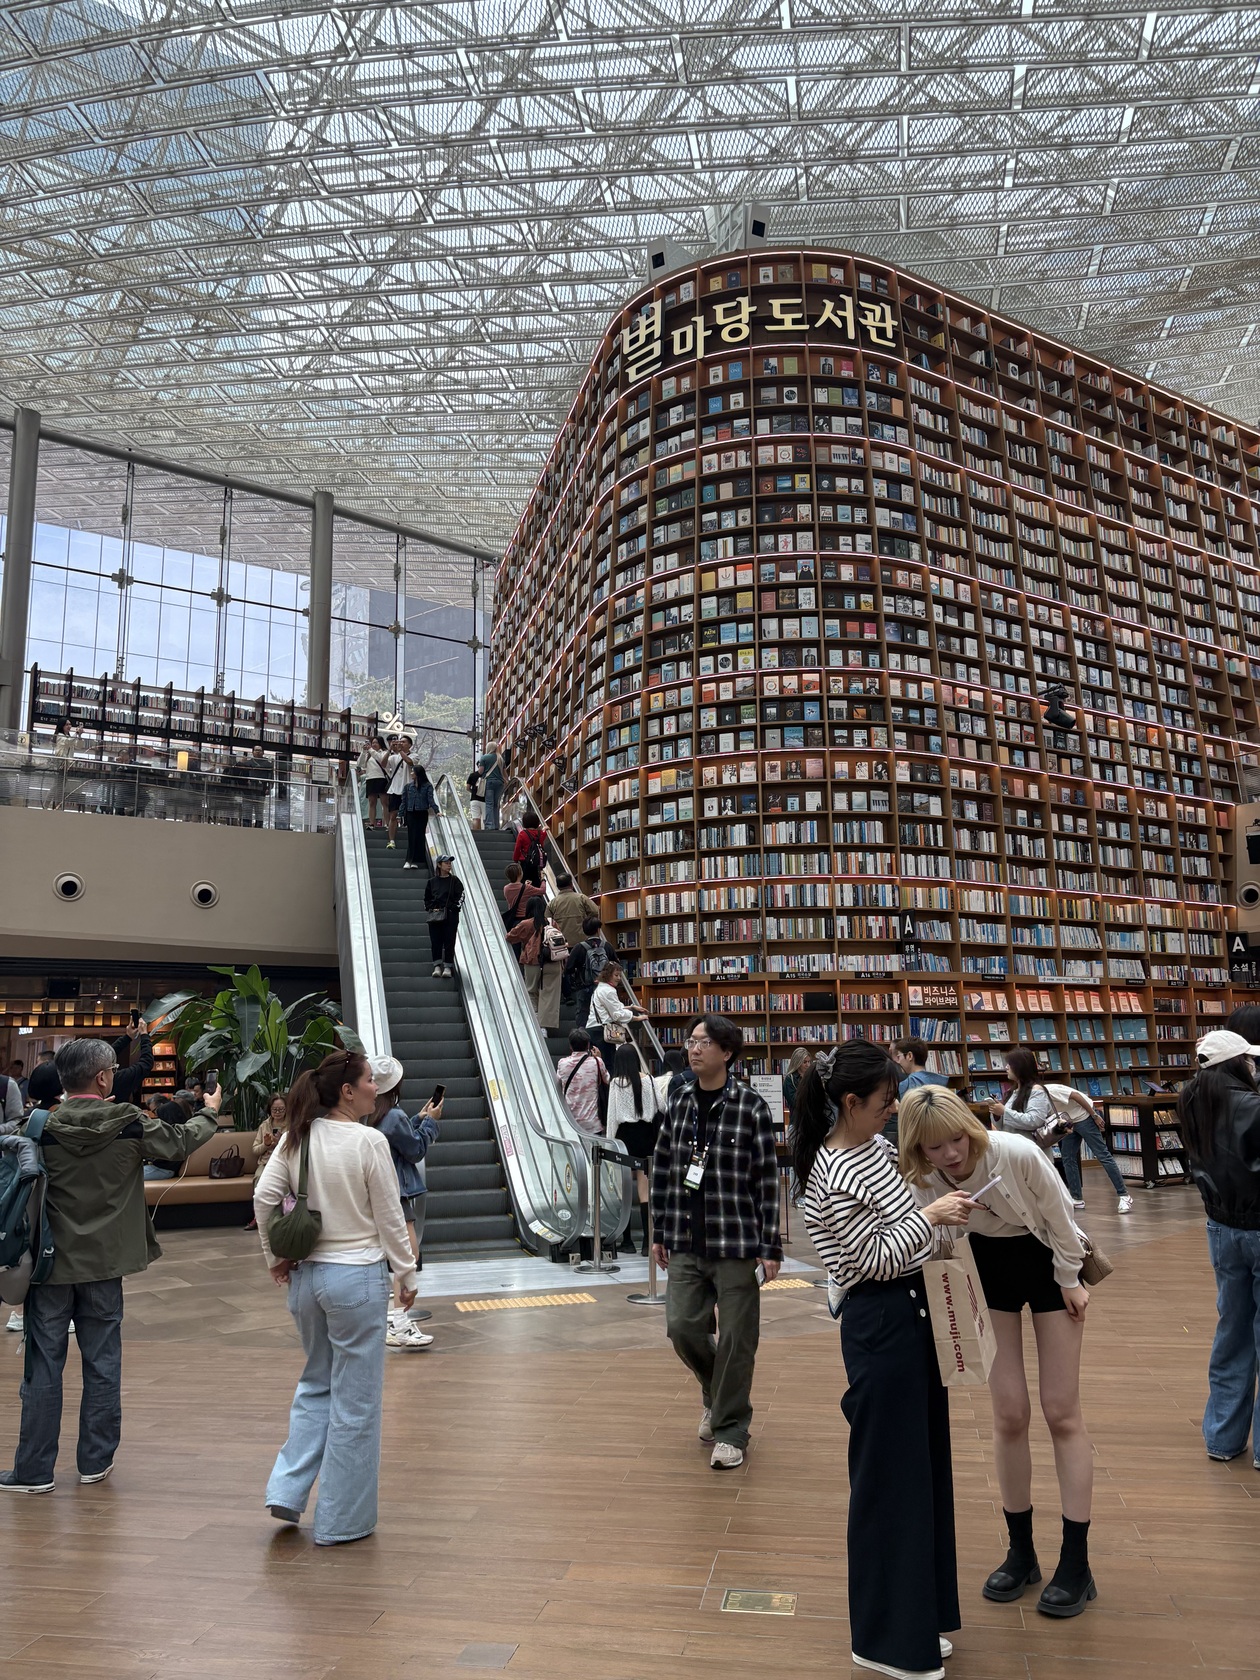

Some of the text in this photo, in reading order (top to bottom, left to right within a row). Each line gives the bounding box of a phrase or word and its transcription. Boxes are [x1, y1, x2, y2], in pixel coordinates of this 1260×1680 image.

[620, 294, 898, 383] 별마당 도서관
[904, 914, 914, 935] A
[1232, 936, 1246, 952] A
[1232, 963, 1249, 972] 소설
[923, 985, 957, 996] 비즈니스
[924, 996, 958, 1006] 라이브러리
[941, 1272, 965, 1372] www.muji.com
